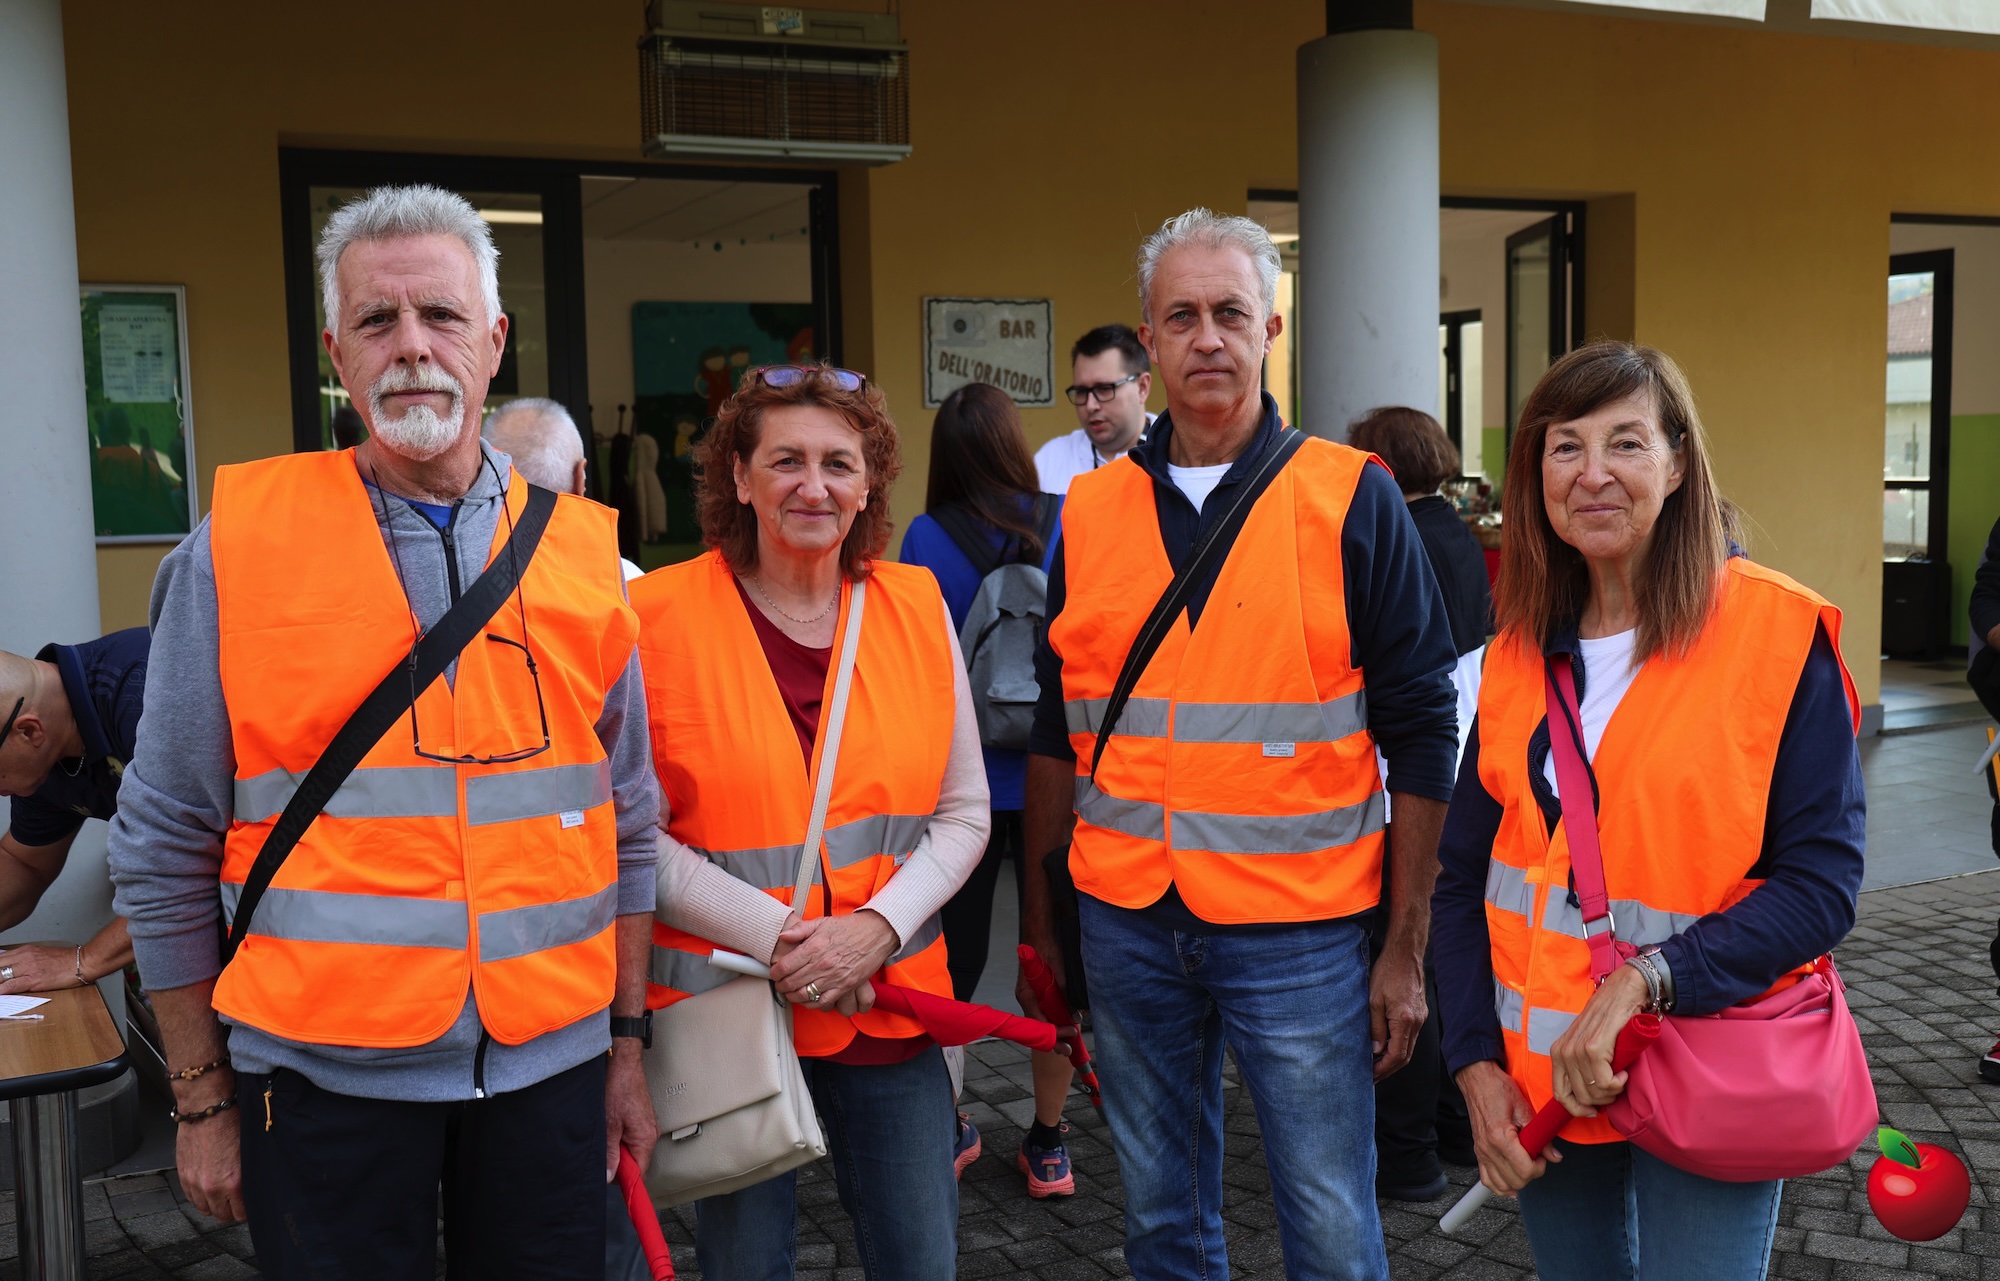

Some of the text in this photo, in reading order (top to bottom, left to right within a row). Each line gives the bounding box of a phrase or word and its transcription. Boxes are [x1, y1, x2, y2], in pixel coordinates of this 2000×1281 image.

[1000, 320, 1036, 339] BAR
[938, 351, 1042, 398] DELL'ORATORIO
[515, 509, 543, 562] WORLD
[264, 775, 328, 868] COVERI
